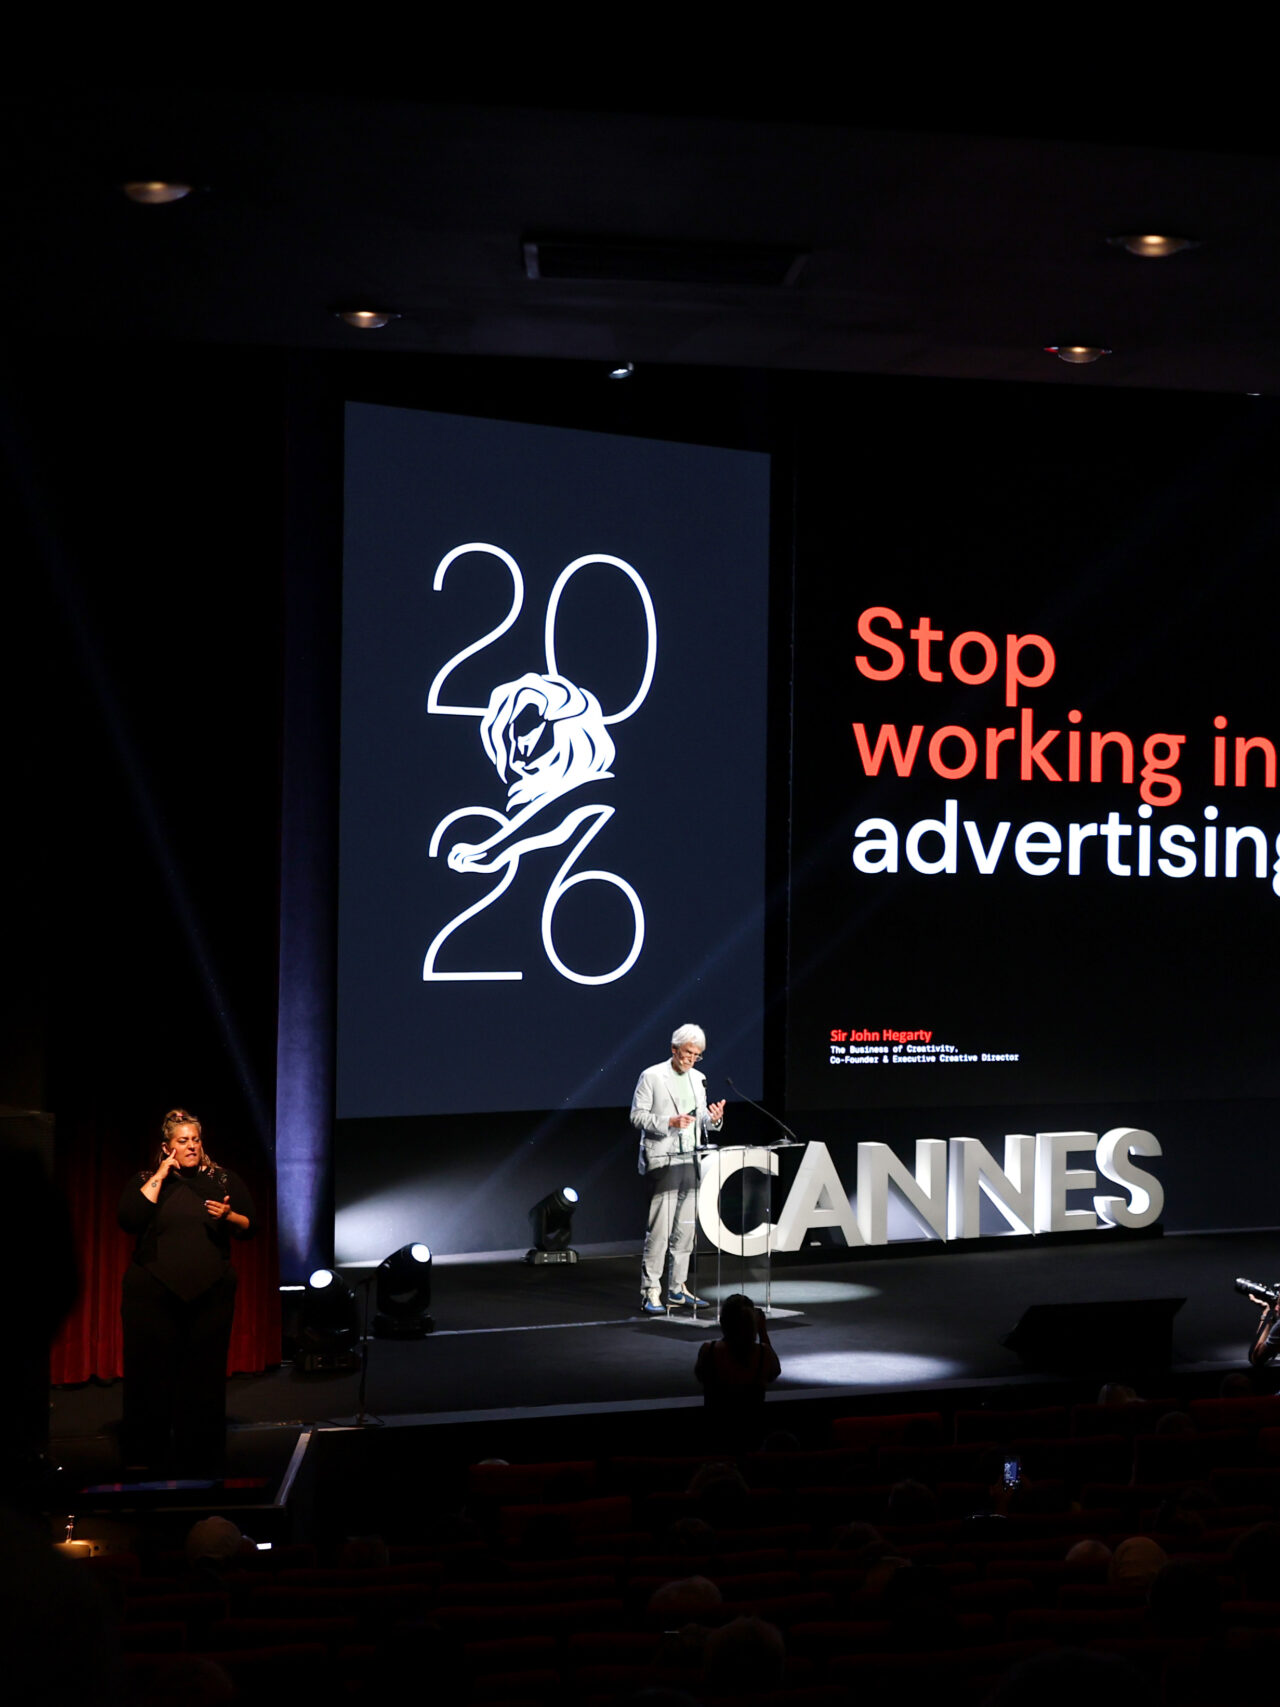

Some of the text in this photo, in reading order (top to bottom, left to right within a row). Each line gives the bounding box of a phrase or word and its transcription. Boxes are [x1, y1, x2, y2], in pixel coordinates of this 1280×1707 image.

[427, 542, 658, 725] 20
[854, 606, 1057, 707] Stop
[852, 707, 1278, 807] working in
[422, 804, 645, 986] 26
[830, 1028, 932, 1043] Sir John Hegarty
[830, 1045, 846, 1054] The
[849, 1045, 889, 1054] Business
[892, 1044, 903, 1053] of
[830, 1053, 1019, 1064] Co-Founder & Executive Creative Director
[698, 1127, 1165, 1258] CANNES
